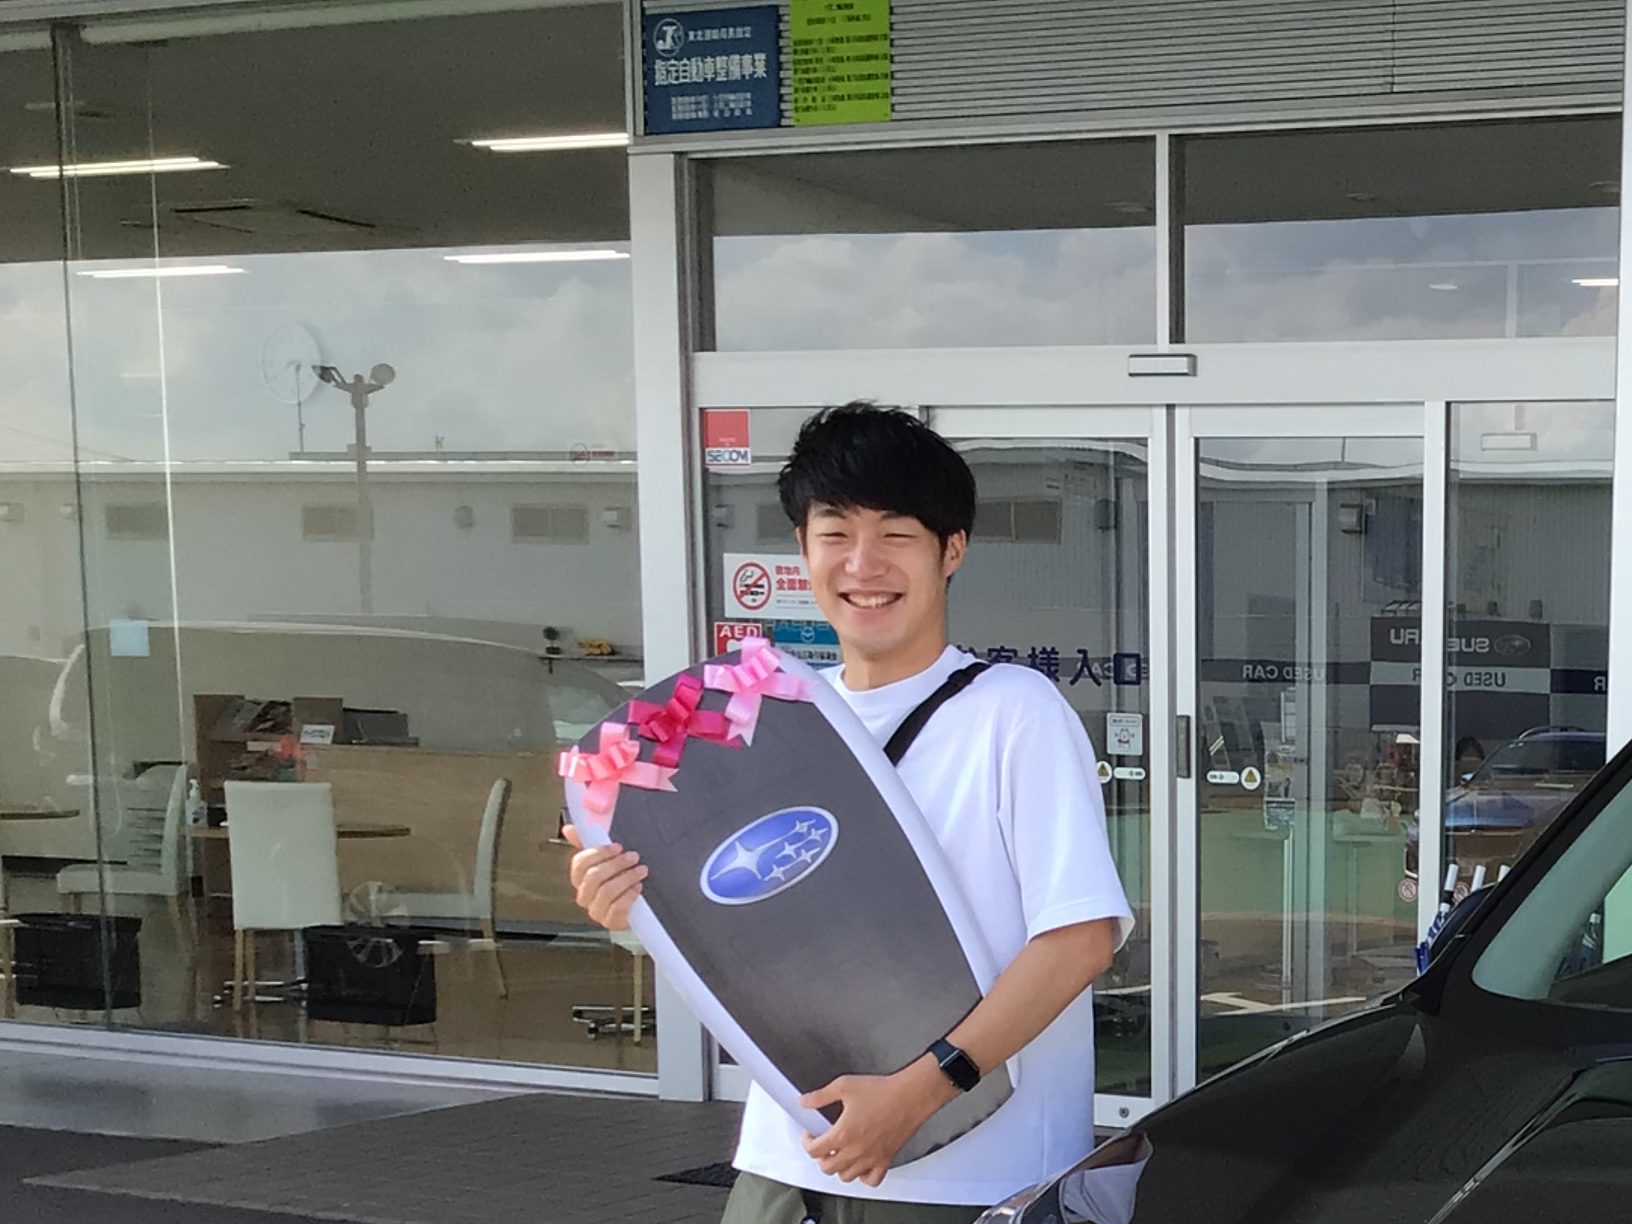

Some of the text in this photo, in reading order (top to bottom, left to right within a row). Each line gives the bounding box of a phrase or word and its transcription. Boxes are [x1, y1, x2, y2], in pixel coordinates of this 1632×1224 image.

[707, 450, 749, 462] SECOM
[776, 578, 812, 591] 全面禁
[720, 624, 758, 639] AED
[957, 645, 1141, 686] 客様入口
